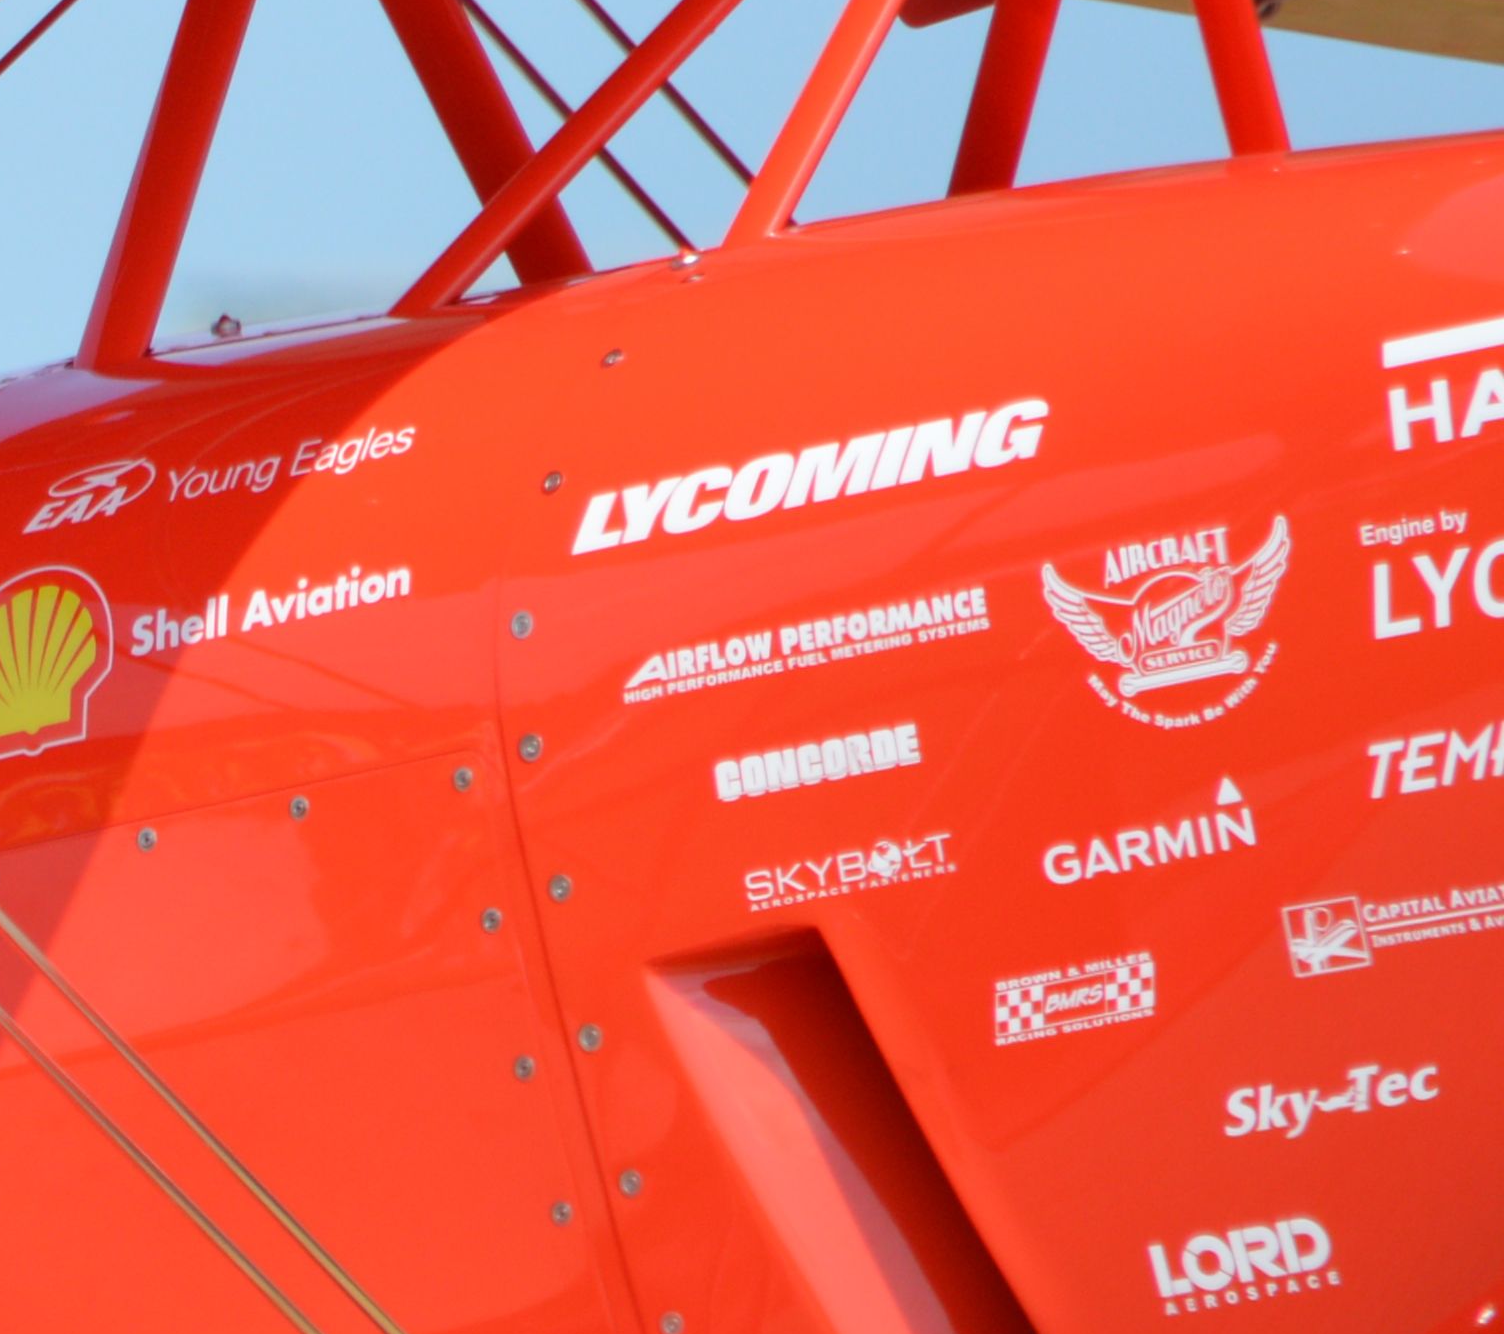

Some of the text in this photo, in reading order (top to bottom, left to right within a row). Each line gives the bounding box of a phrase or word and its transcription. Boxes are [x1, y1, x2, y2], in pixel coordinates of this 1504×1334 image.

[167, 425, 416, 503] Young Eagles
[571, 398, 1049, 556] LYCOMING
[22, 485, 128, 535] EAA
[1360, 510, 1468, 546] Engine by
[1104, 526, 1228, 589] AIRCRAFT
[131, 566, 411, 657] Shell Aviation
[624, 587, 987, 689] AIRFLOW PERFORMANCE
[1118, 566, 1231, 664] Magneto
[623, 617, 990, 704] HIGH PERFORMANCE FUEL METERING SYSTEMS
[1088, 642, 1278, 729] May The Spark Be With You
[1145, 645, 1216, 669] SERVICE
[714, 723, 921, 802] CONCORDE
[1367, 720, 1504, 799] TEM
[744, 832, 951, 902] SKYBOLT
[1043, 808, 1257, 885] GARMIN
[750, 863, 957, 912] AEROSPACE FASTENERS
[1469, 917, 1482, 932] &
[995, 951, 1152, 992] BROWN & MILLER
[1045, 983, 1105, 1014] BMRS
[995, 1008, 1154, 1046] RACING SOLUTIONS
[1148, 1217, 1332, 1298] LORD
[1164, 1270, 1342, 1316] AEROSPACE
